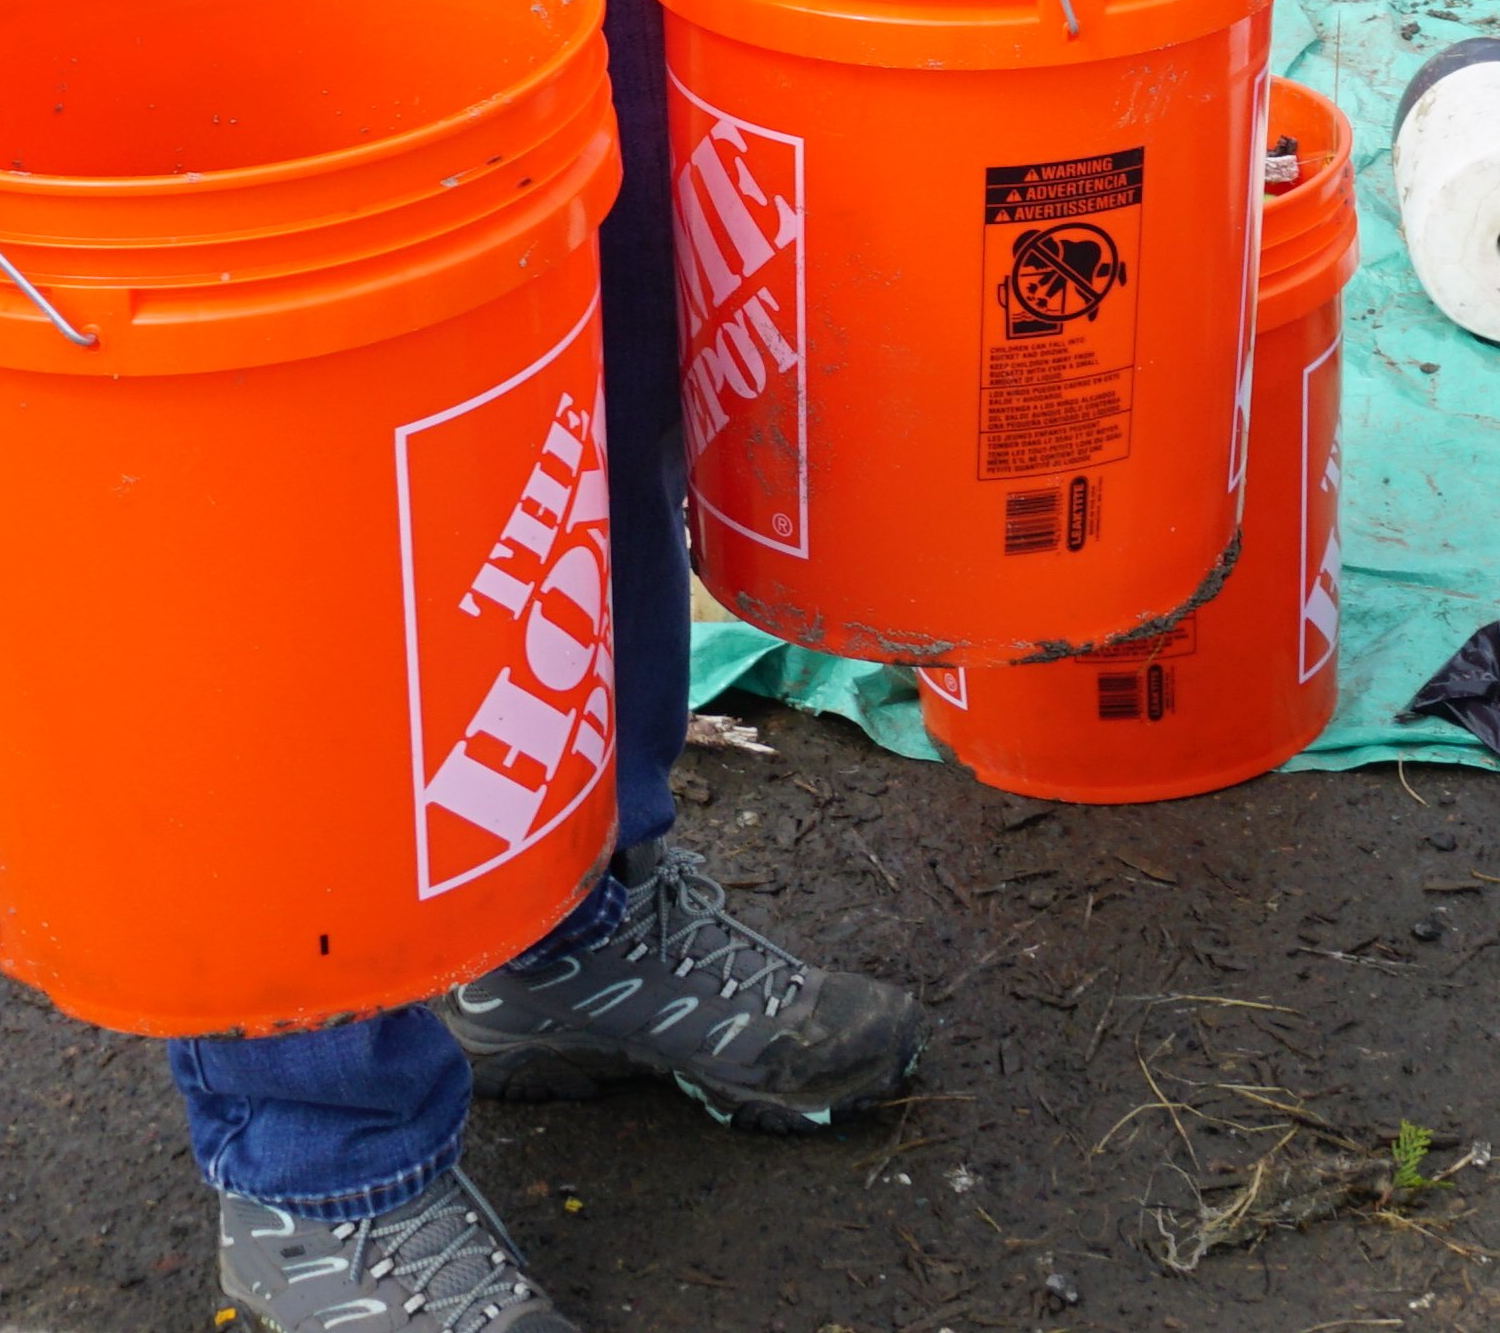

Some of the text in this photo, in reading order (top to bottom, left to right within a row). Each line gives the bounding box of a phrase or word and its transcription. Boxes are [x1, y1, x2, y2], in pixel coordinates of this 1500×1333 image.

[1041, 157, 1113, 181] WARNING
[1025, 173, 1128, 201] ADVERTENCIA
[1014, 190, 1136, 221] AVERTISSEMENT
[459, 392, 590, 620] THE
[1070, 483, 1085, 546] LEAKTITE
